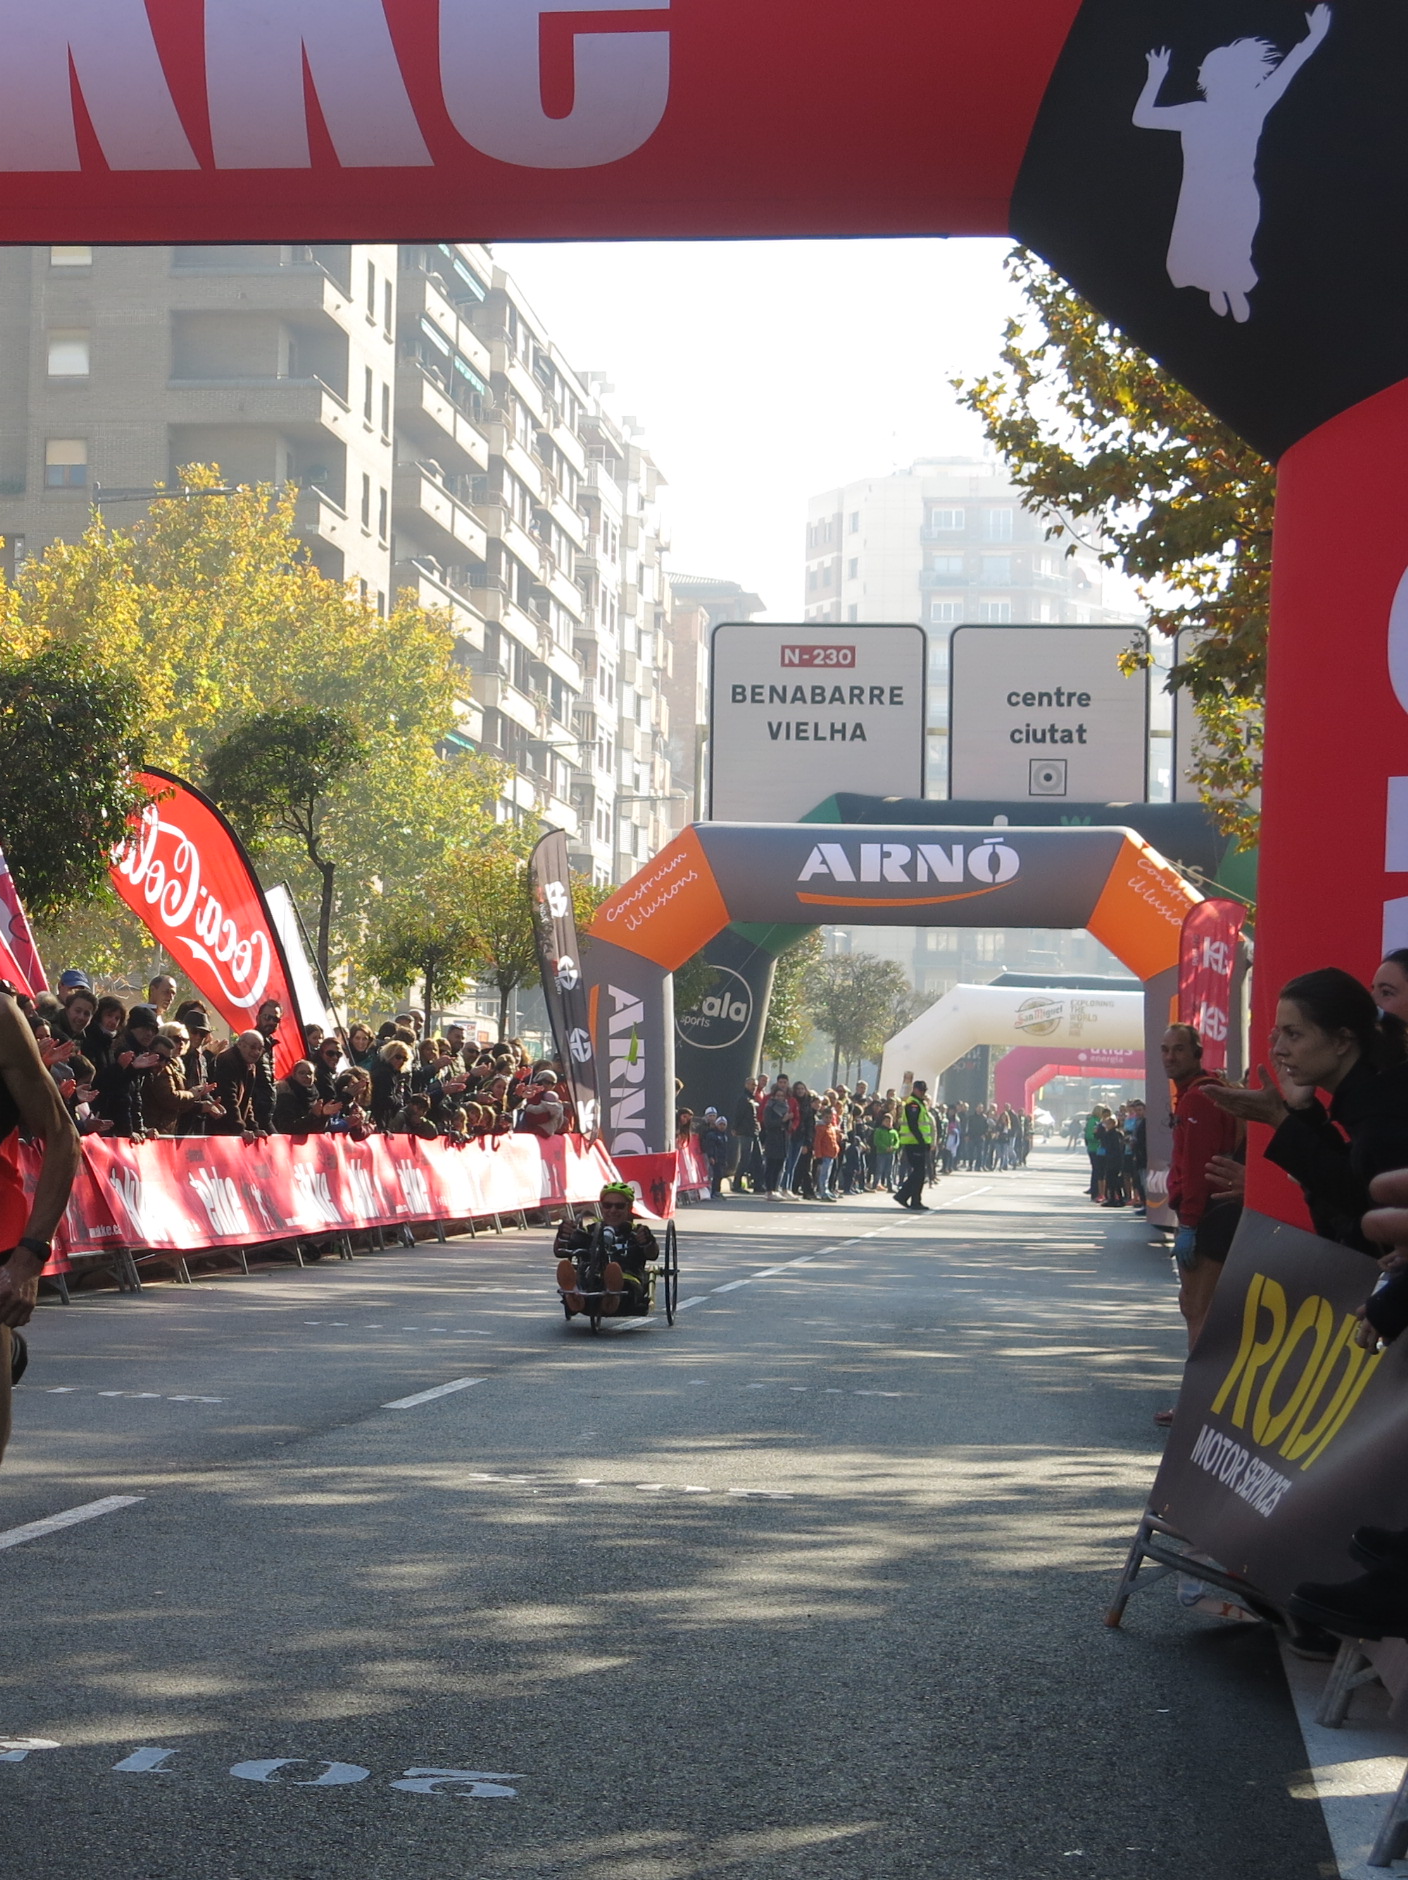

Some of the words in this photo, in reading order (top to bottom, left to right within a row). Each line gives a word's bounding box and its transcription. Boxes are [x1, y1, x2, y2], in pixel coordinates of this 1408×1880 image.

[784, 648, 853, 665] N-230
[731, 683, 904, 706] BENABARRE
[1007, 686, 1091, 708] centre
[767, 721, 867, 742] VIELHA
[1009, 723, 1087, 745] ciutat
[1210, 1272, 1387, 1472] RODI
[1190, 1423, 1249, 1494] MOTOR
[1234, 1454, 1292, 1518] SERVICES
